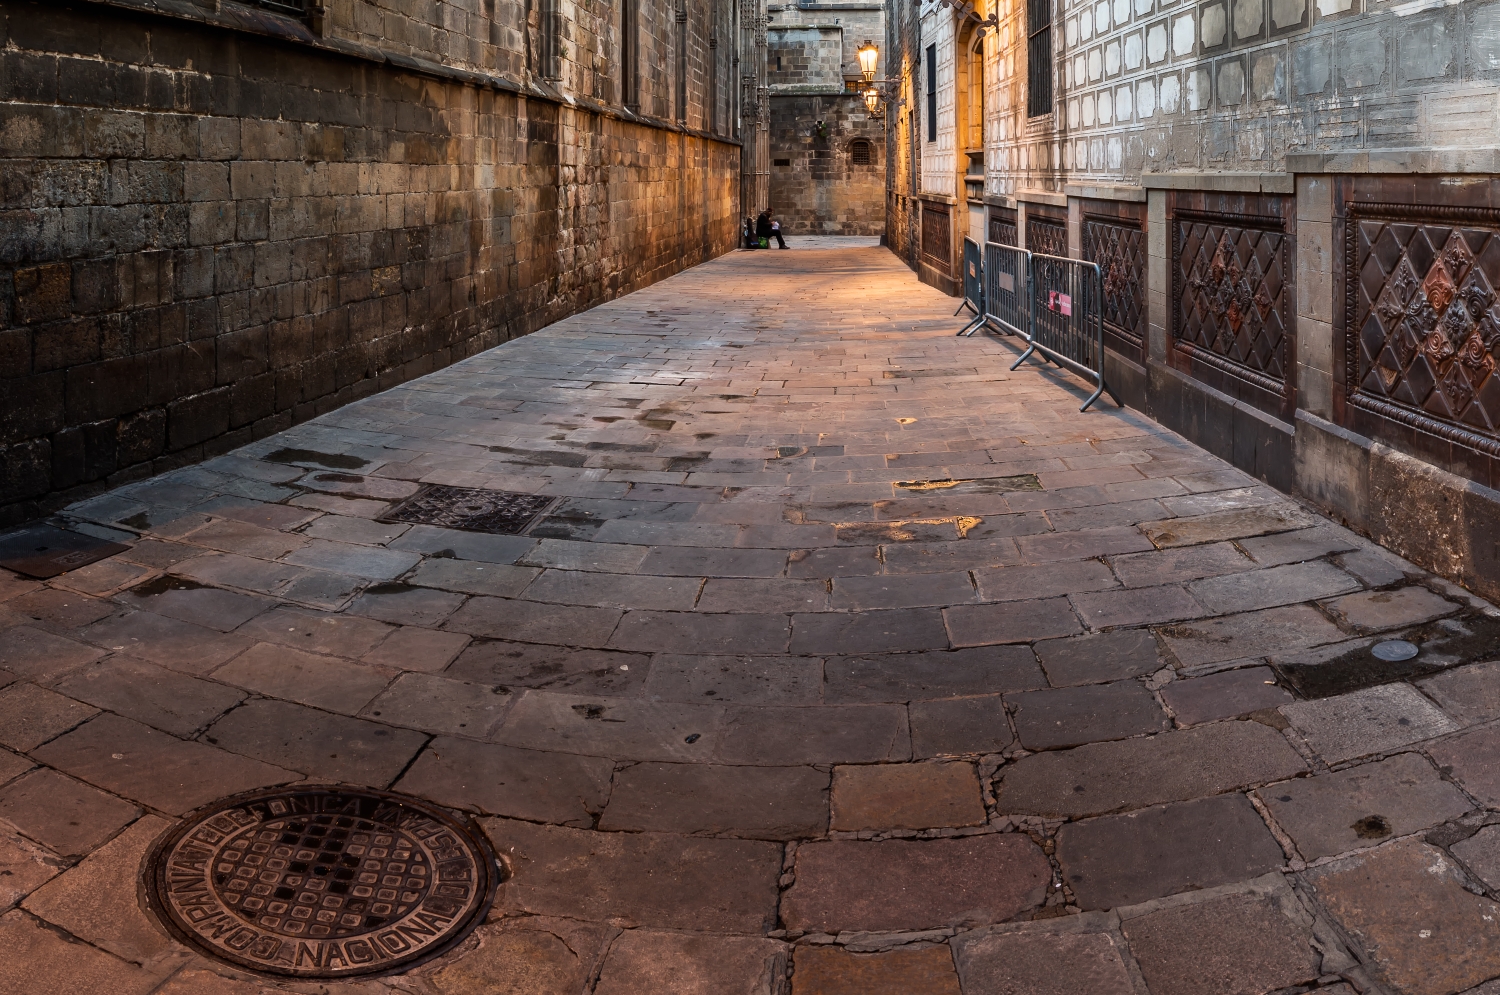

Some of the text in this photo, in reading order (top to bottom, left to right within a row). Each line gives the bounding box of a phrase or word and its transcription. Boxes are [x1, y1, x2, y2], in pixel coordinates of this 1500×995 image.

[179, 796, 361, 858] TELEFONICA
[294, 905, 464, 967] NACIONAL
[434, 862, 472, 901] DE
